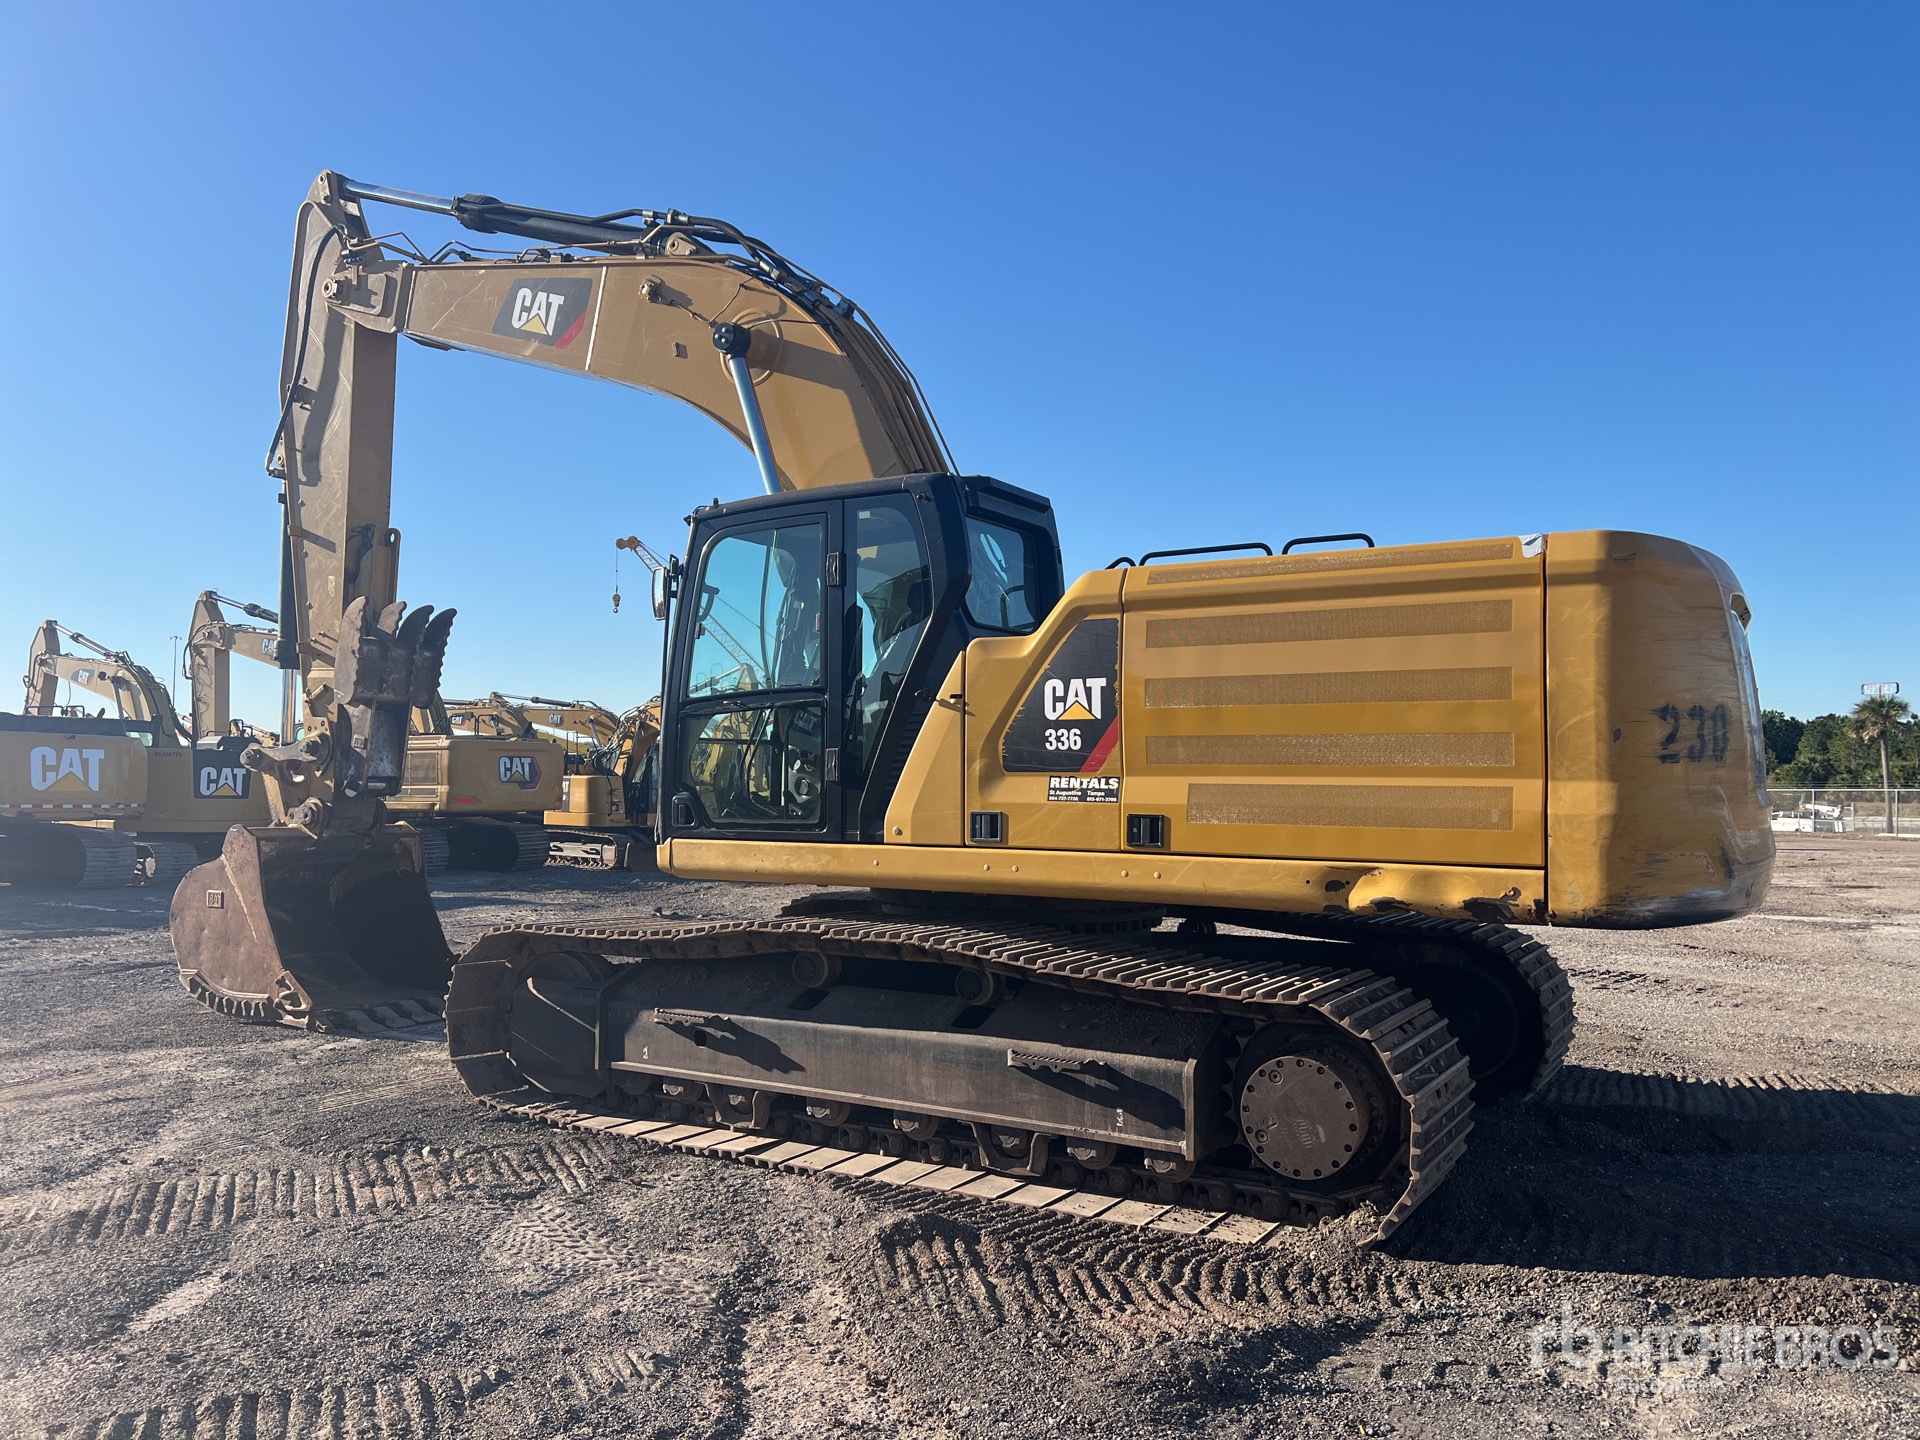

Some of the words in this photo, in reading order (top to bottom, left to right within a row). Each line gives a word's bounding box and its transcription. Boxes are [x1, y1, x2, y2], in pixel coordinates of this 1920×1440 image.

[511, 287, 565, 336] CAT
[262, 639, 275, 655] CA
[78, 669, 89, 685] CAT
[1044, 678, 1107, 720] CAT
[451, 715, 463, 725] CAT
[549, 713, 562, 725] CAT
[1045, 728, 1082, 750] 336
[1659, 704, 1729, 763] 230
[30, 746, 105, 791] CAT
[500, 757, 531, 782] CAT
[200, 767, 247, 796] CAT
[1050, 777, 1118, 789] RENTALS
